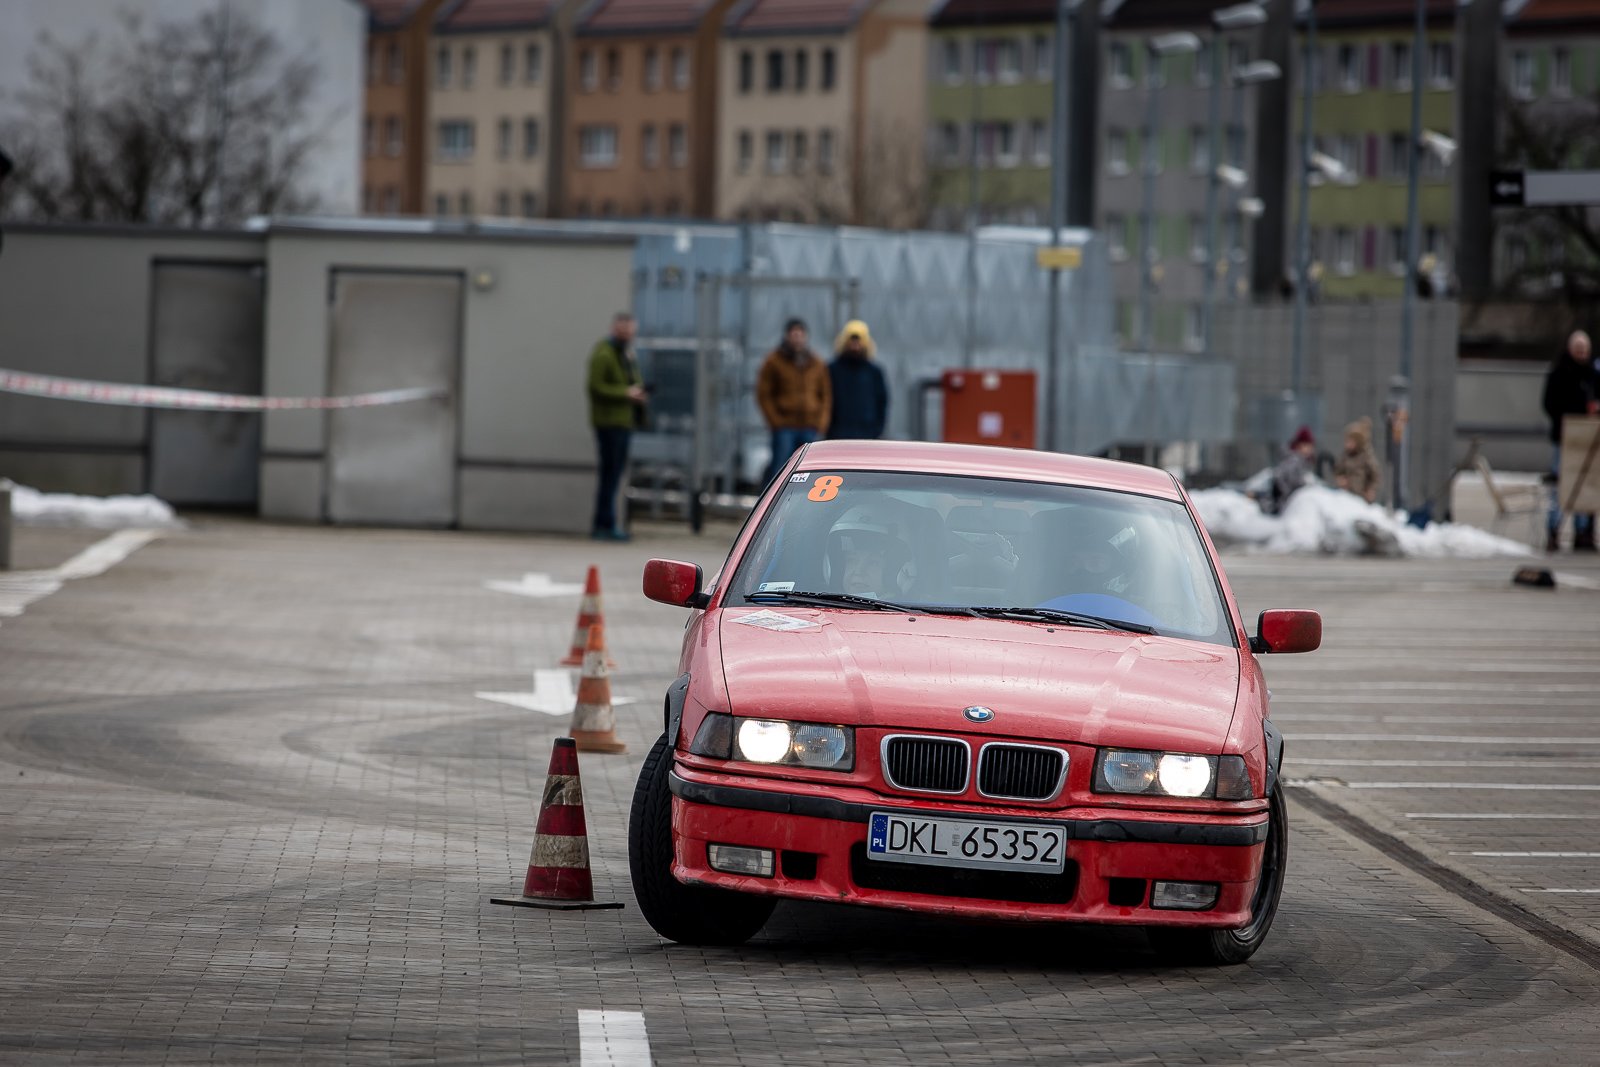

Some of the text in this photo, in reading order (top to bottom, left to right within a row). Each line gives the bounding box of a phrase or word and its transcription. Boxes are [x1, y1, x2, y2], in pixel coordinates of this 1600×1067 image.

[807, 475, 844, 502] 8
[873, 838, 884, 847] PL
[889, 820, 1059, 863] DKL 65352
